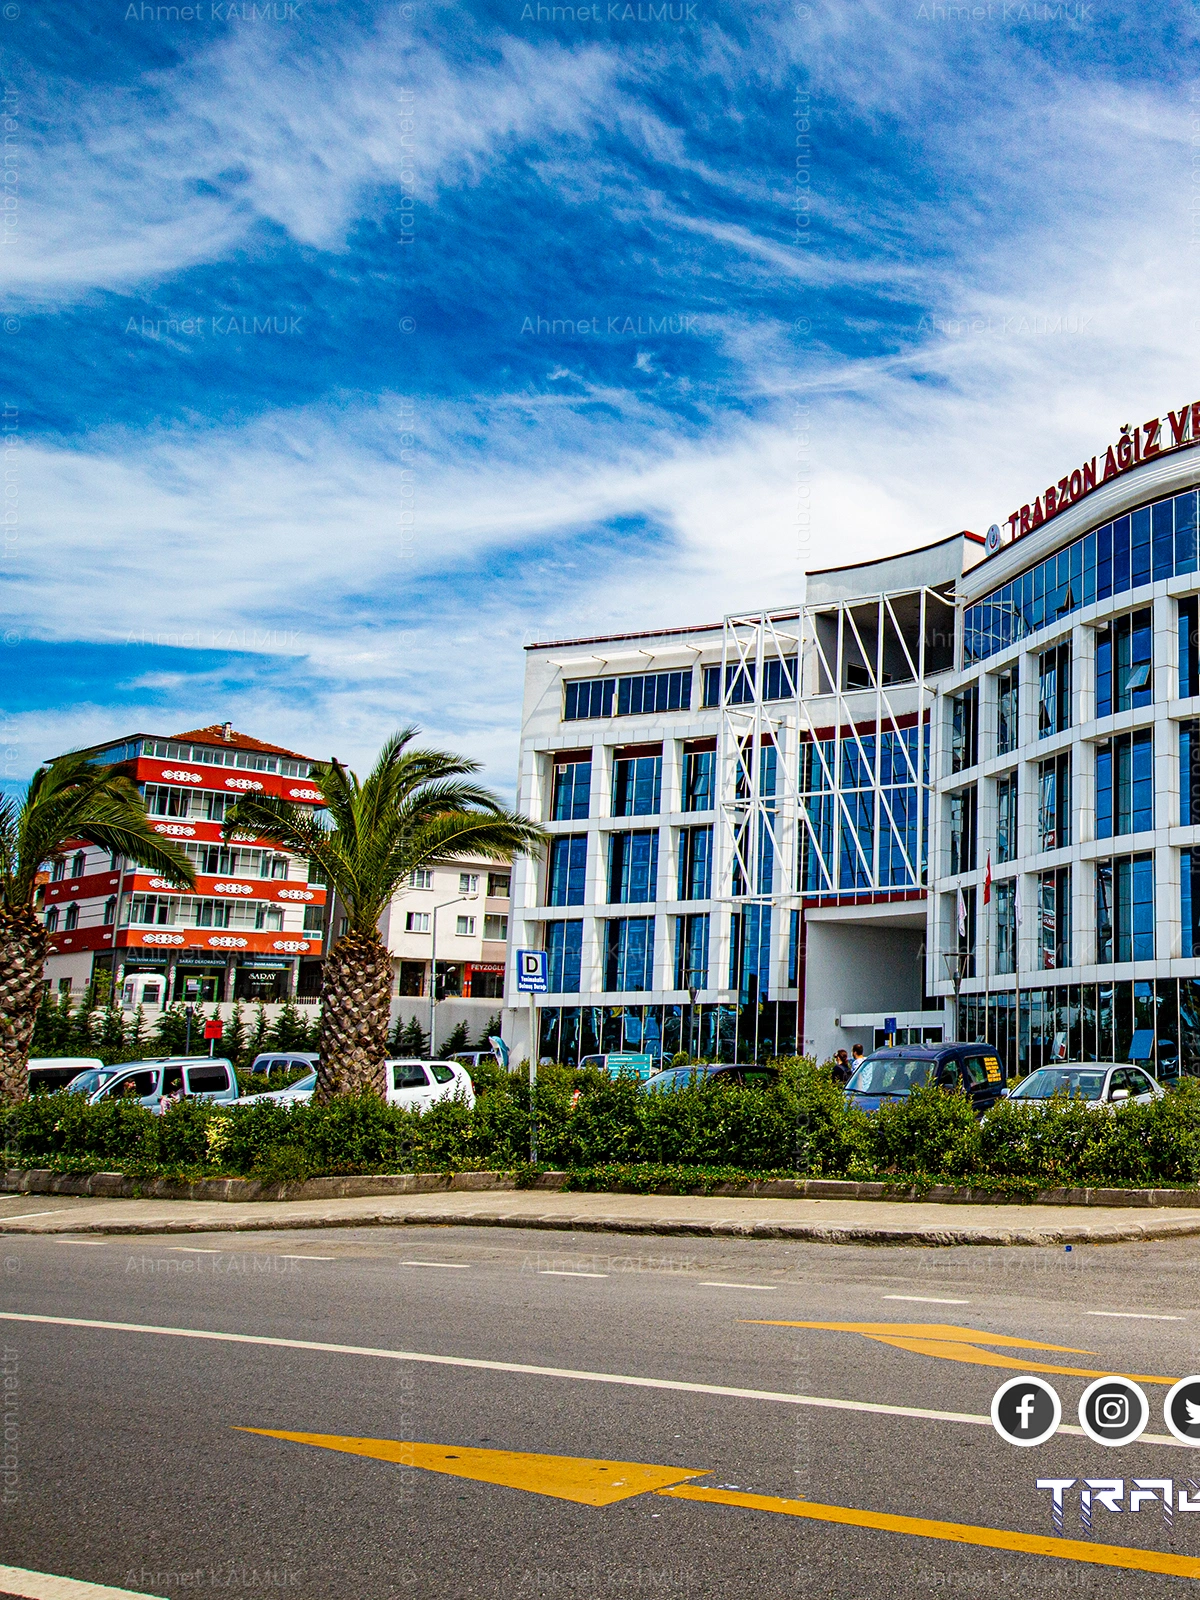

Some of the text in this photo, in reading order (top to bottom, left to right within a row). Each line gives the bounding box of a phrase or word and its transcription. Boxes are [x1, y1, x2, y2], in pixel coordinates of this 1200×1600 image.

[1008, 456, 1097, 542] TRABZON
[1103, 418, 1161, 481] AĞIZ
[526, 956, 538, 973] D
[248, 972, 276, 980] SARAY
